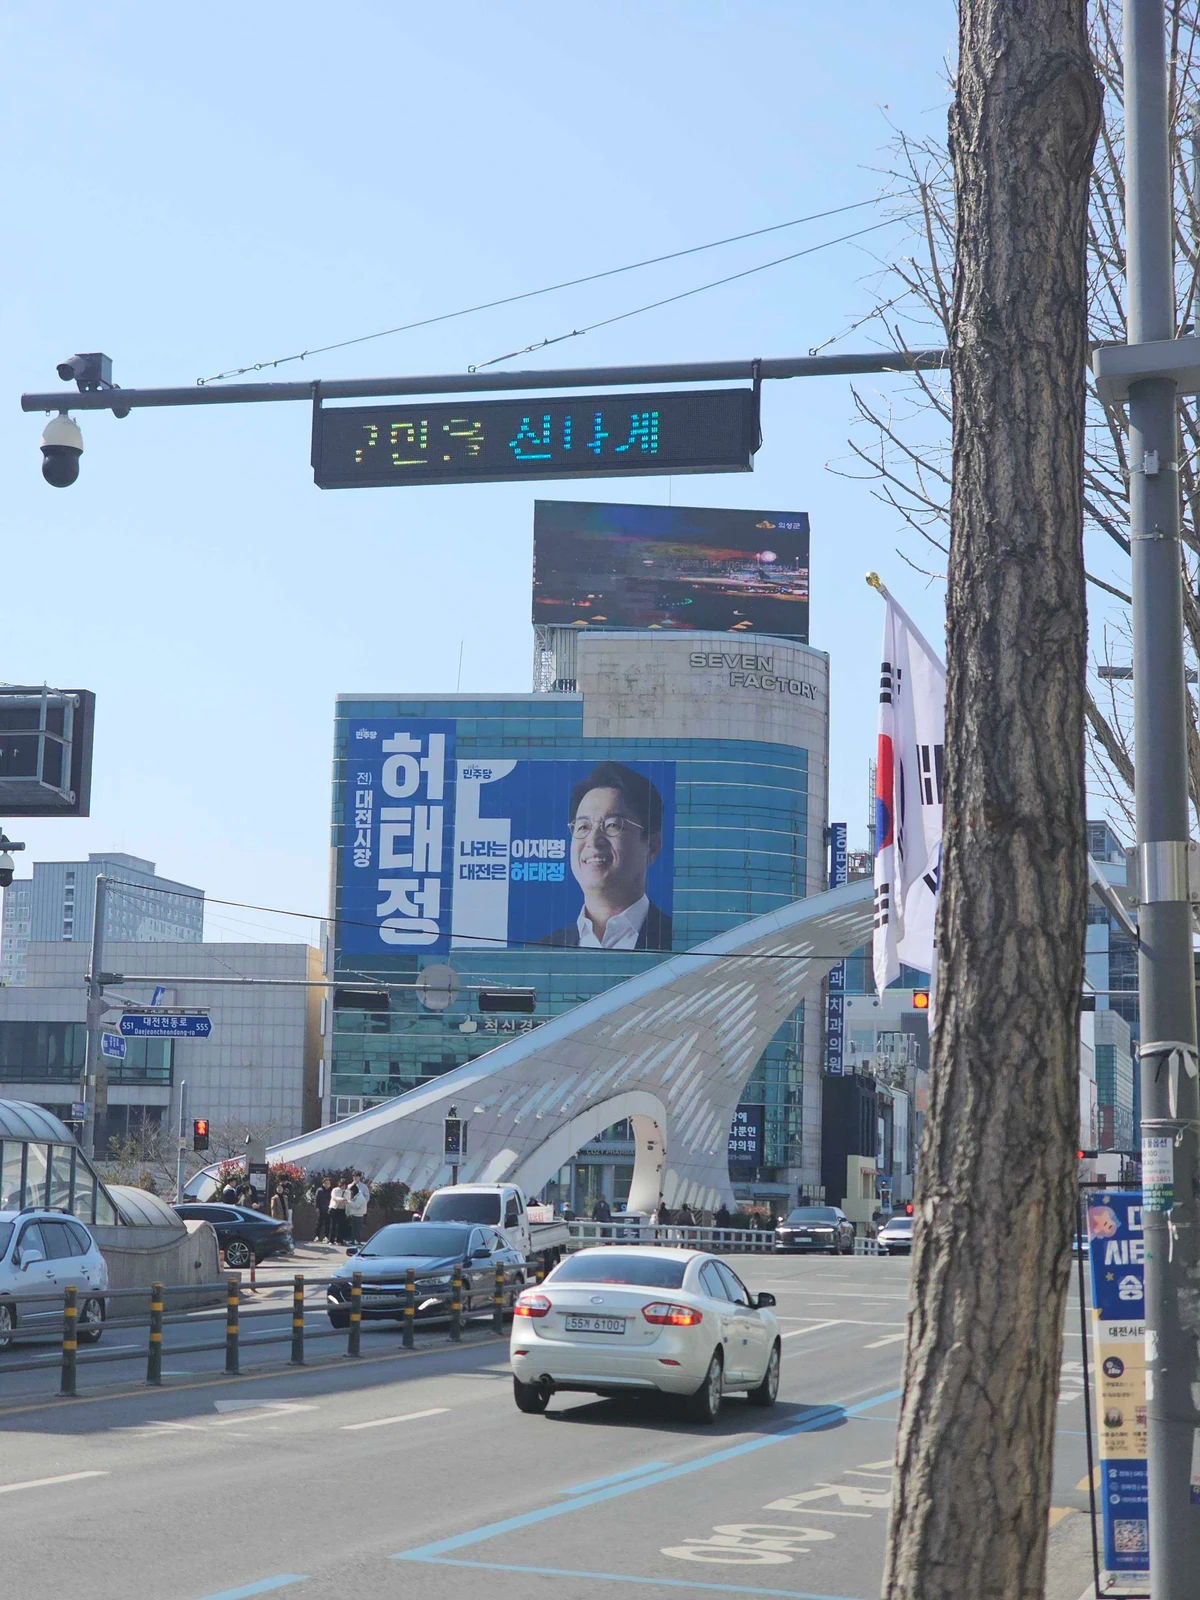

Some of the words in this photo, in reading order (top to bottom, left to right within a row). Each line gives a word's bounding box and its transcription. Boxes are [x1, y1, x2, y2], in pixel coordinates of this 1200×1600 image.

[777, 521, 801, 530] 의성군
[690, 652, 774, 672] SEVEN
[730, 672, 818, 700] FACTORY
[355, 731, 378, 740] 민주당
[463, 768, 493, 780] 민주당
[353, 790, 374, 868] 대전시장
[376, 732, 446, 945] 허태정
[460, 840, 507, 857] 나라는
[511, 839, 565, 859] 이재명
[836, 826, 847, 862] FLOW
[459, 863, 506, 880] 대전은
[511, 862, 565, 882] 허태정
[122, 1021, 134, 1030] 551
[143, 1017, 188, 1028] 대전천동로
[196, 1023, 209, 1031] 555
[134, 1028, 196, 1036] Daejeoncheondong-ro
[828, 997, 843, 1073] 치과의원
[1118, 1274, 1145, 1301] 승
[594, 1319, 620, 1330] 6100
